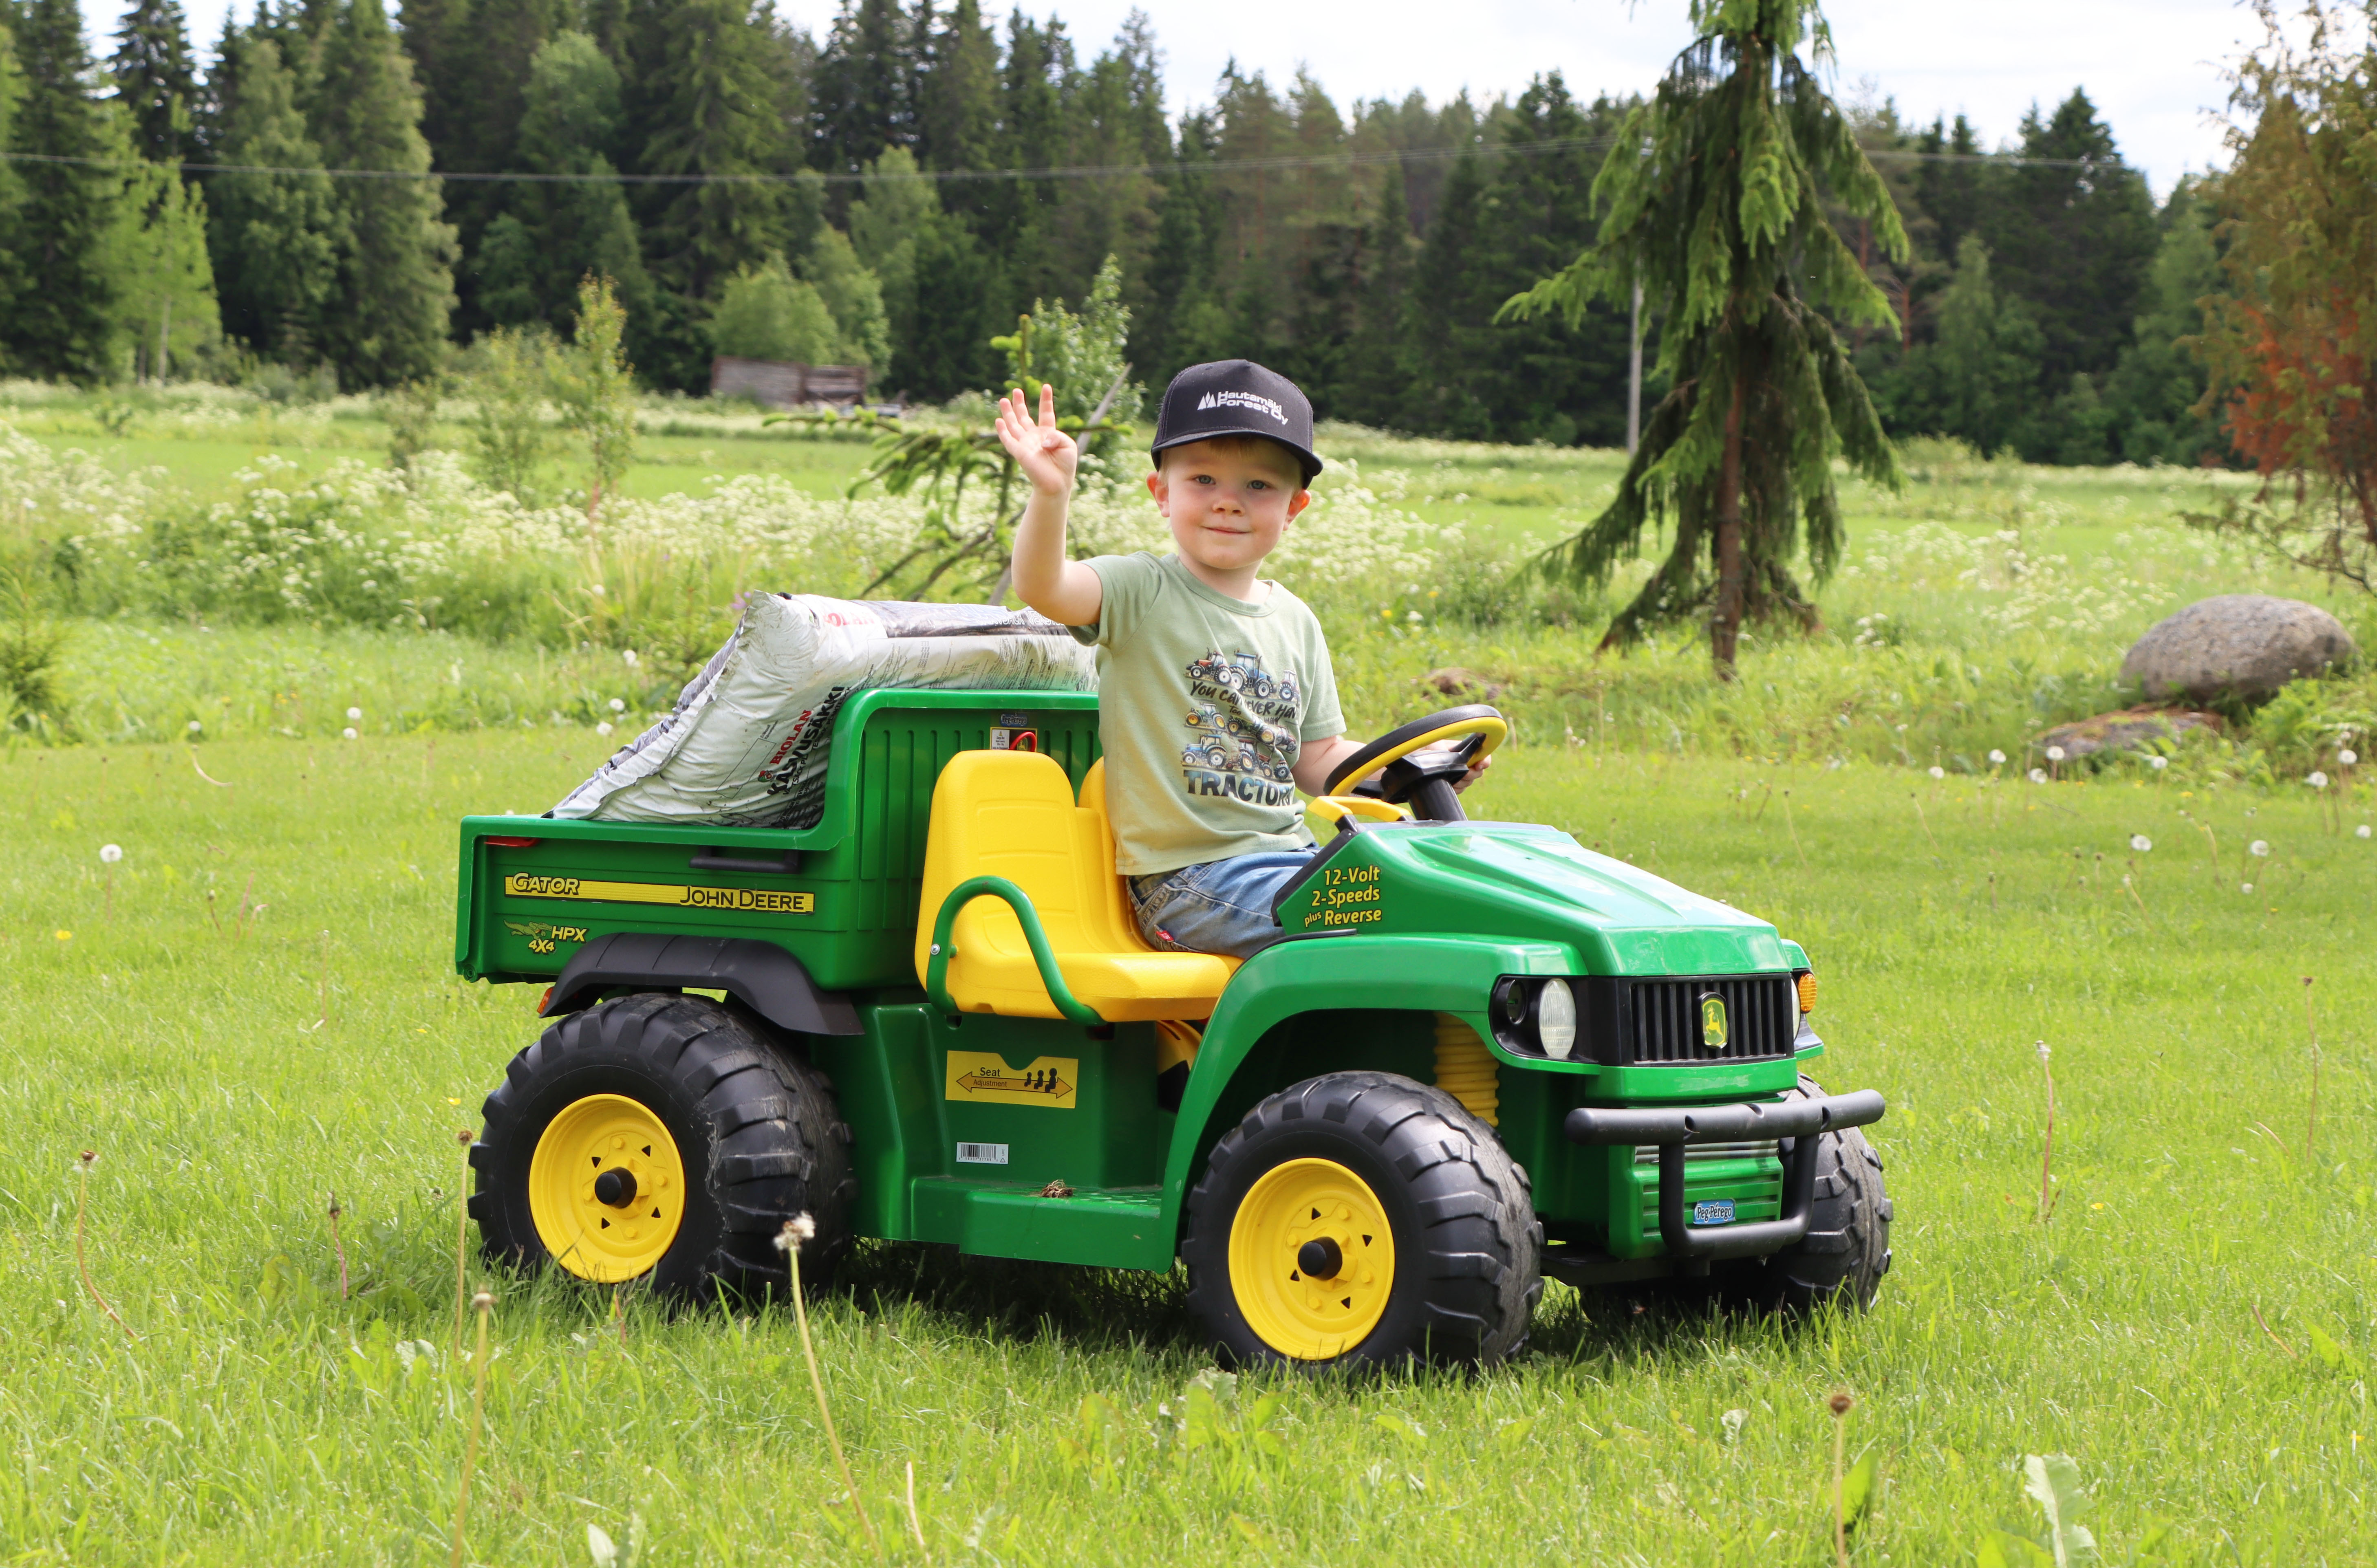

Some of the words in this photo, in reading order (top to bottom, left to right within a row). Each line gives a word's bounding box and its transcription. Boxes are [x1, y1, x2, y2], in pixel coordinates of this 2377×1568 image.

[1217, 399, 1269, 413] Forest
[1271, 409, 1288, 425] Oy
[1218, 391, 1282, 412] Hautamäki
[1191, 681, 1217, 696] YOU
[1245, 699, 1275, 715] EVER
[767, 686, 845, 796] KASVUSÄKKI
[770, 709, 812, 764] BIOLAN
[1325, 865, 1380, 885] 12-Volt
[512, 872, 580, 895] GATOR
[680, 885, 734, 907] JOHN
[739, 889, 805, 910] DEERE
[1312, 885, 1380, 908] 2-Speeds
[1304, 911, 1322, 927] plus
[1325, 909, 1382, 925] Reverse
[551, 925, 587, 943] HPX
[528, 939, 555, 954] 4X4
[980, 1067, 1001, 1077] Seat
[973, 1079, 1007, 1088] Adjustment
